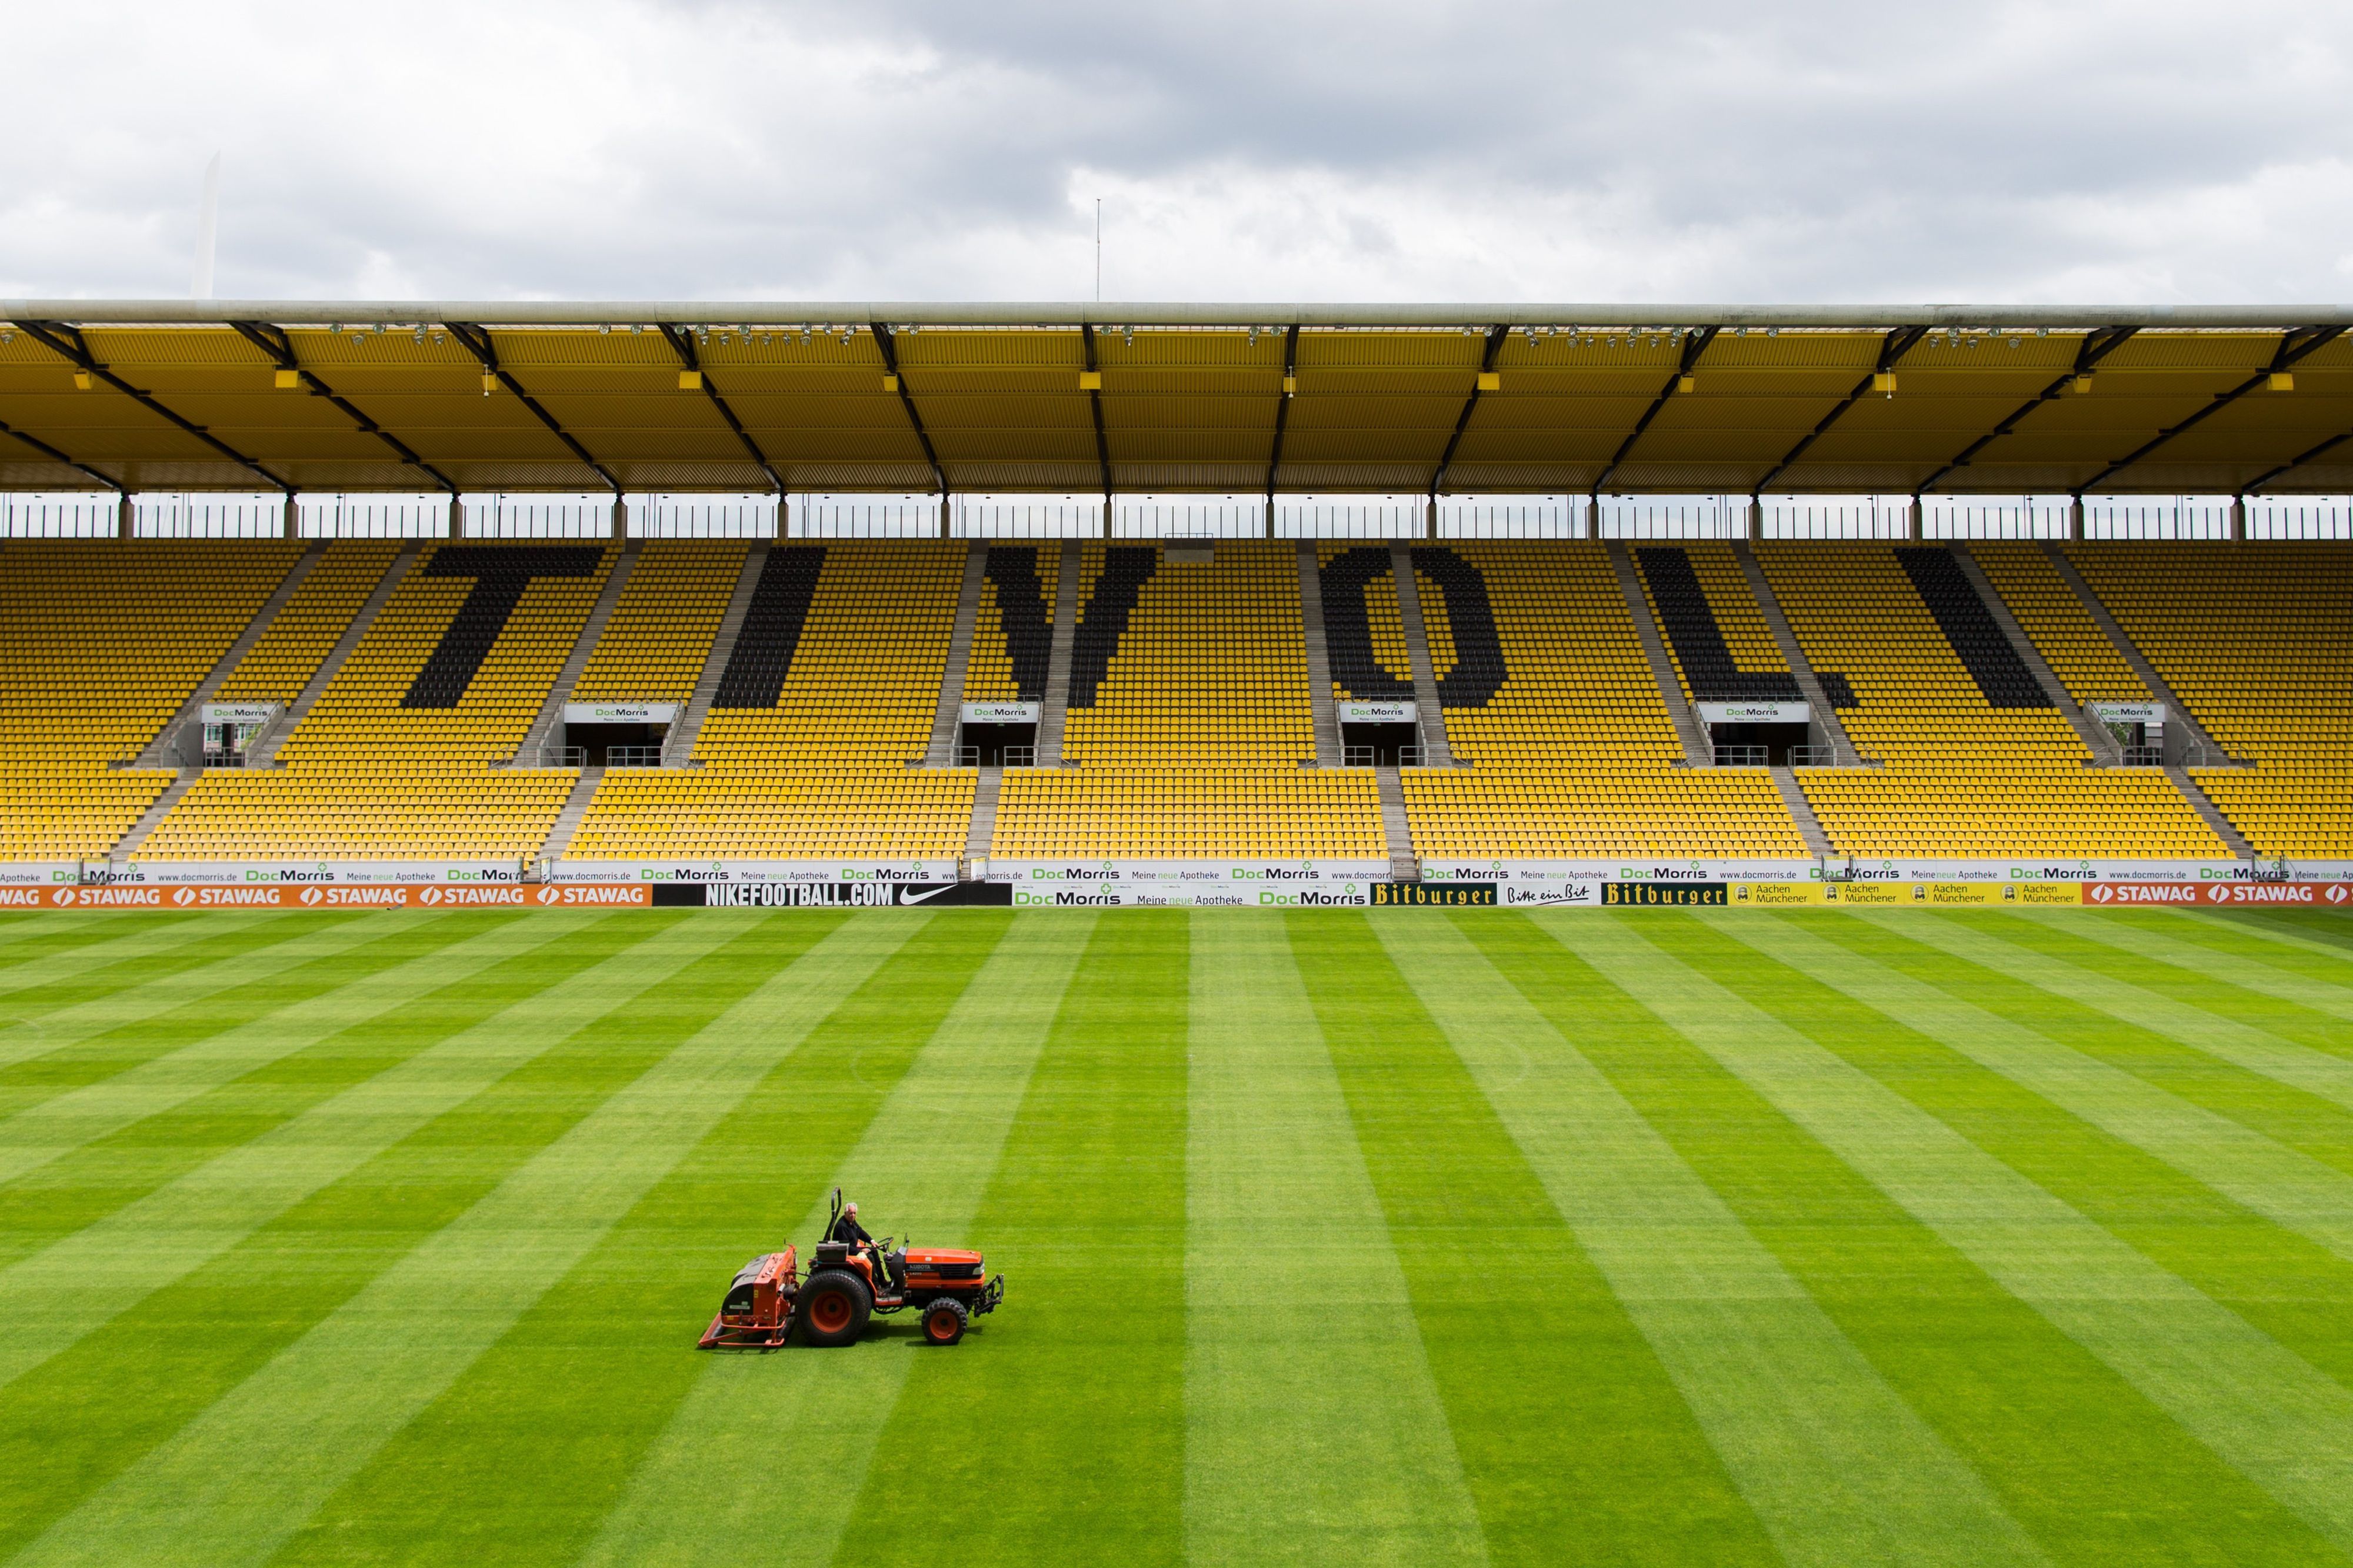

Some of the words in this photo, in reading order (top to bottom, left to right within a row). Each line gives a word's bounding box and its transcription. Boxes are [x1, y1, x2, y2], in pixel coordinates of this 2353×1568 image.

[0, 874, 41, 882] Apotheke
[246, 870, 334, 881] DocMorris
[395, 873, 435, 882] Apotheke
[553, 871, 631, 880] www.docmorris.de
[641, 869, 728, 880] DocMorris
[741, 871, 765, 880] Meine
[789, 871, 829, 881] Apotheke
[842, 869, 929, 879] DocMorris
[1032, 868, 1120, 879] DocMorris
[1180, 871, 1219, 880] Apotheke
[1232, 868, 1319, 879] DocMorris
[1424, 868, 1508, 879] DocMorris
[1521, 870, 1545, 879] Meine
[1569, 870, 1608, 880] Apotheke
[1621, 868, 1707, 878] DocMorris
[1912, 870, 1935, 879] Meine
[1958, 870, 1997, 880] Apotheke
[2011, 868, 2097, 878] DocMorris
[2200, 868, 2289, 879] DocMorris
[2342, 871, 2353, 880] Ap
[1508, 887, 1537, 903] Bitte
[1540, 890, 1562, 899] ein
[1565, 883, 1589, 898] Bit
[1756, 885, 1790, 893] Aachen
[1845, 885, 1879, 893] Aachen
[1933, 885, 1967, 893] Aachen
[2023, 885, 2057, 893] Aachen
[2117, 886, 2195, 901] STAWAG
[2234, 886, 2312, 901] STAWAG
[79, 889, 160, 905] STAWAG
[200, 889, 280, 904] STAWAG
[327, 889, 406, 903] STAWAG
[445, 888, 524, 903] STAWAG
[564, 888, 643, 903] STAWAG
[706, 884, 893, 906] NIKEFOOTBALL.COM
[1015, 892, 1121, 905] DocMorris
[1260, 892, 1365, 905] DocMorris
[1374, 884, 1491, 905] Bitburger
[1607, 884, 1722, 905] Bitburger
[1756, 893, 1807, 903] Münchener
[1845, 893, 1896, 903] Münchener
[1933, 893, 1984, 903] Münchener
[2023, 893, 2074, 903] Münchener
[1138, 896, 1166, 905] Meine
[1195, 896, 1242, 906] Apotheke
